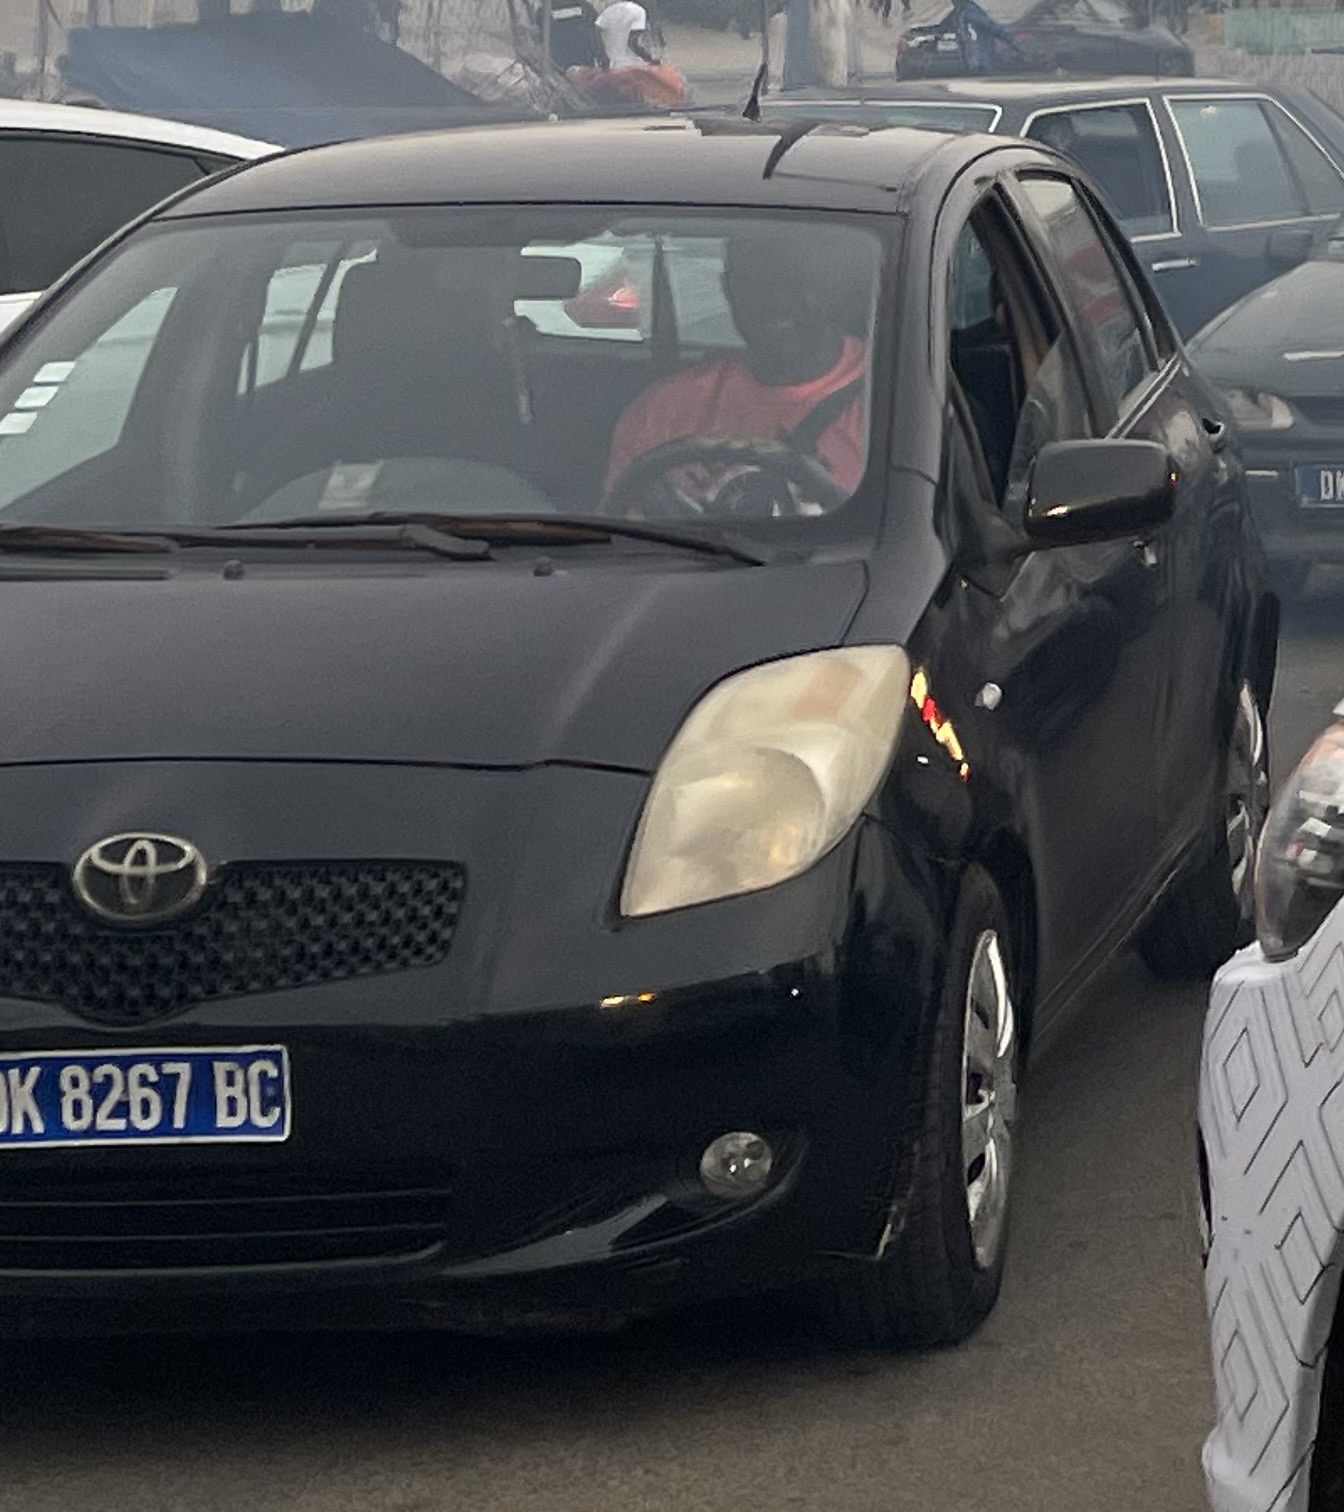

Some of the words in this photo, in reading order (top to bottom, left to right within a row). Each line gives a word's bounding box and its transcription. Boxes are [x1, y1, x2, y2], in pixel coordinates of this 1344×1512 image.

[0, 1066, 45, 1135] K
[59, 1062, 191, 1131] 8267
[213, 1058, 281, 1129] BC
